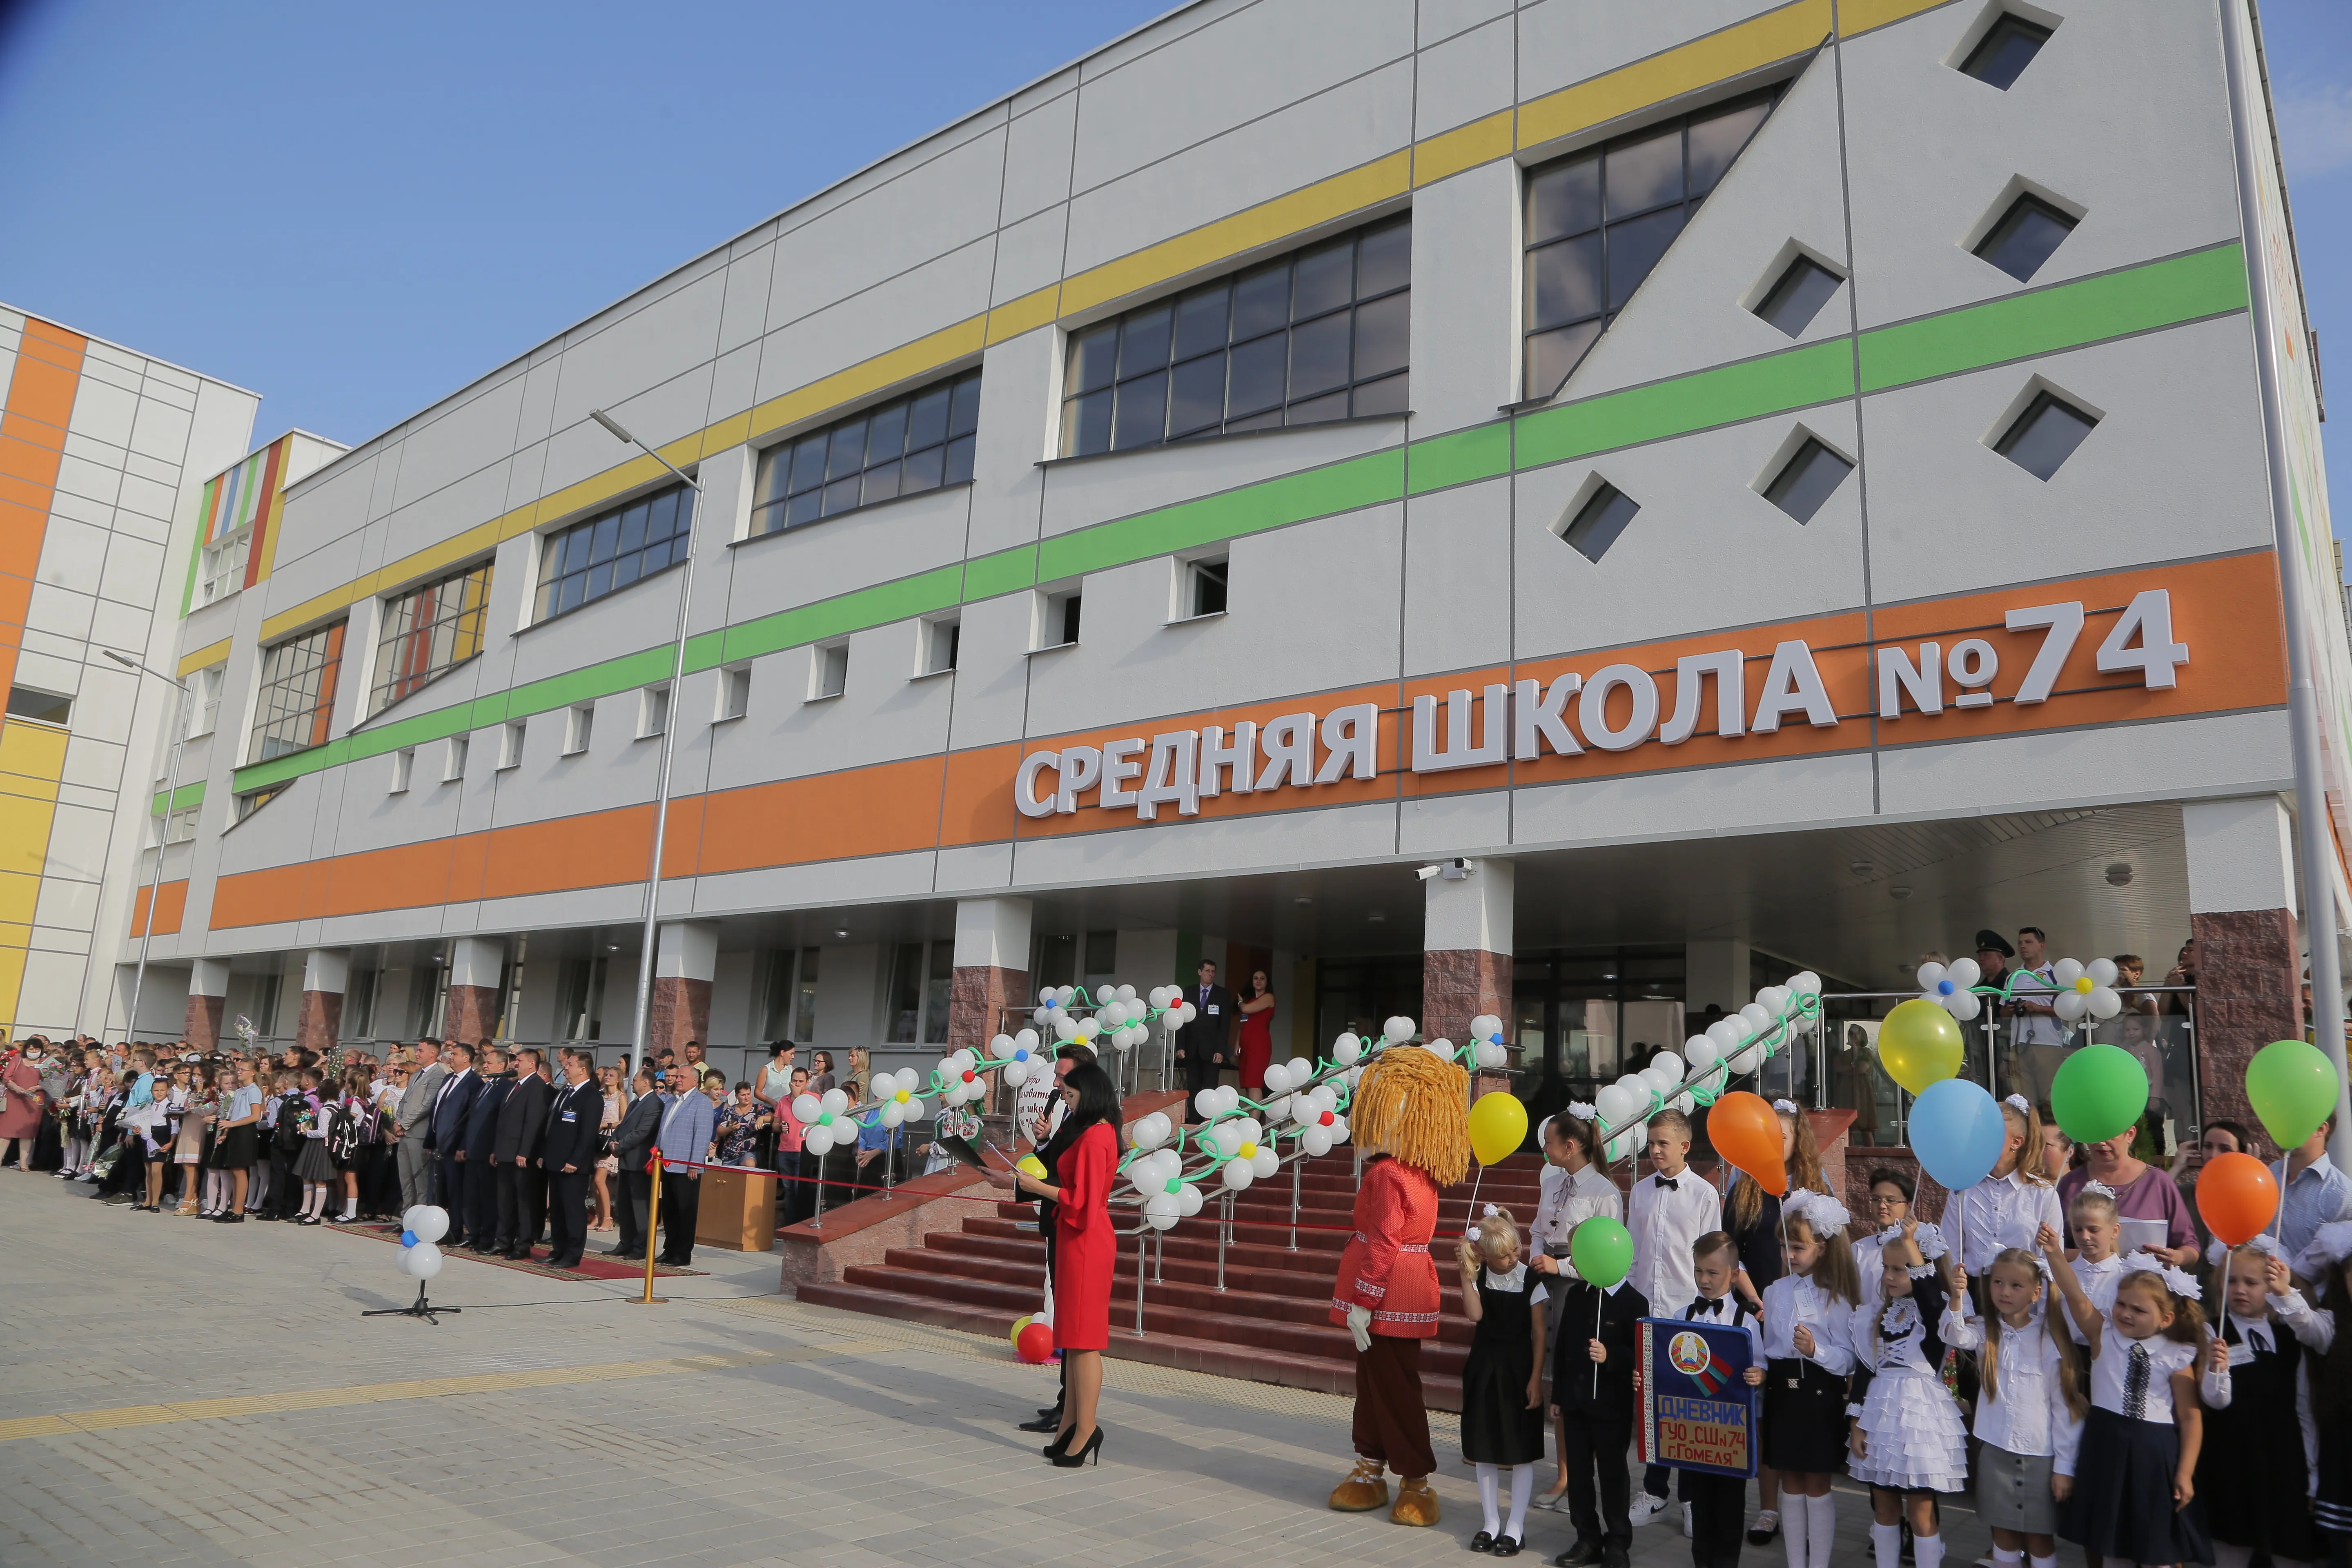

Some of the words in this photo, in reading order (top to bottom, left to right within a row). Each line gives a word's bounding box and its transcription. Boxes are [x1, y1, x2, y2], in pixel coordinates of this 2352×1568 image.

[1014, 703, 1378, 820] СРЕДНЯЯ
[1412, 639, 1839, 774] ШКОЛА
[1659, 1396, 1745, 1426] ДНЕВНИК
[1659, 1421, 1687, 1441] ГУО
